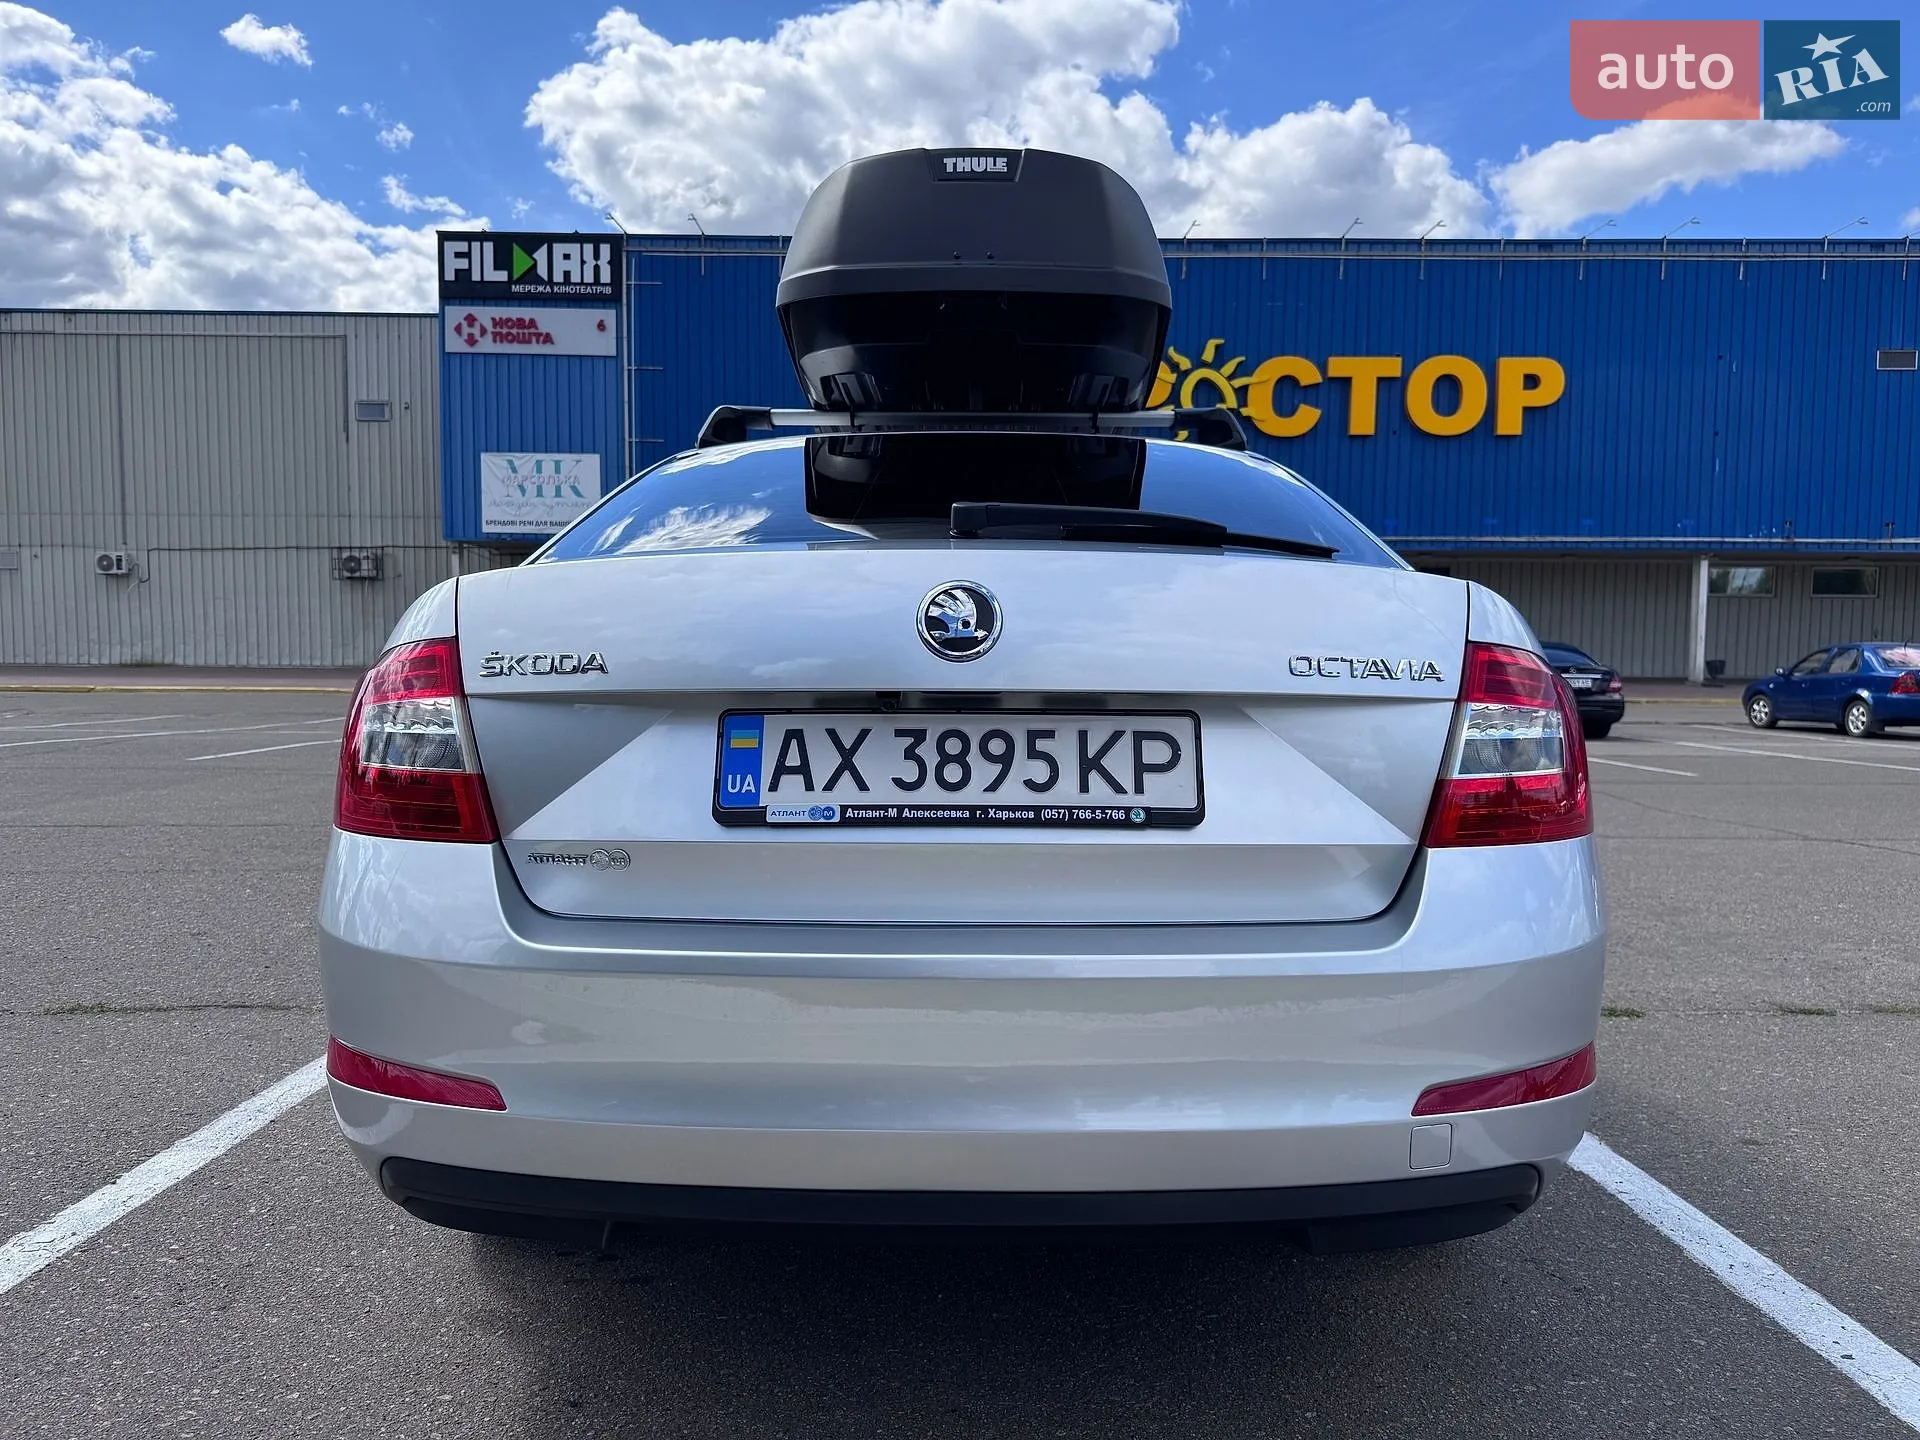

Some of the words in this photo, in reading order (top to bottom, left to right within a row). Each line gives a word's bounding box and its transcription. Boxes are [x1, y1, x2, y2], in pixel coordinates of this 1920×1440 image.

[943, 157, 1008, 173] THULE
[443, 240, 612, 284] FILMAX
[511, 284, 552, 294] МЕРЕЖА
[553, 285, 612, 295] КІНОТЕАТРІВ
[490, 316, 540, 331] НОВА
[596, 319, 607, 333] 6
[490, 331, 555, 345] ПОШТА
[1147, 352, 1566, 438] ОСТОР
[485, 519, 518, 527] БРЕНДОВІ
[519, 520, 534, 528] РЕЧІ
[534, 520, 548, 528] ДЛЯ
[479, 651, 609, 678] ŠKODA
[1289, 655, 1446, 682] OCTAVIA
[767, 728, 873, 793] AX
[891, 729, 1060, 793] 3895
[1077, 730, 1182, 794] KP
[726, 774, 756, 794] UA
[845, 807, 898, 818] Атлант-М
[902, 807, 970, 818] Алексеевка
[976, 810, 985, 818] г.
[988, 808, 1035, 821] Харьков
[1041, 808, 1069, 821] (057)
[1071, 809, 1126, 820] 766-5-766
